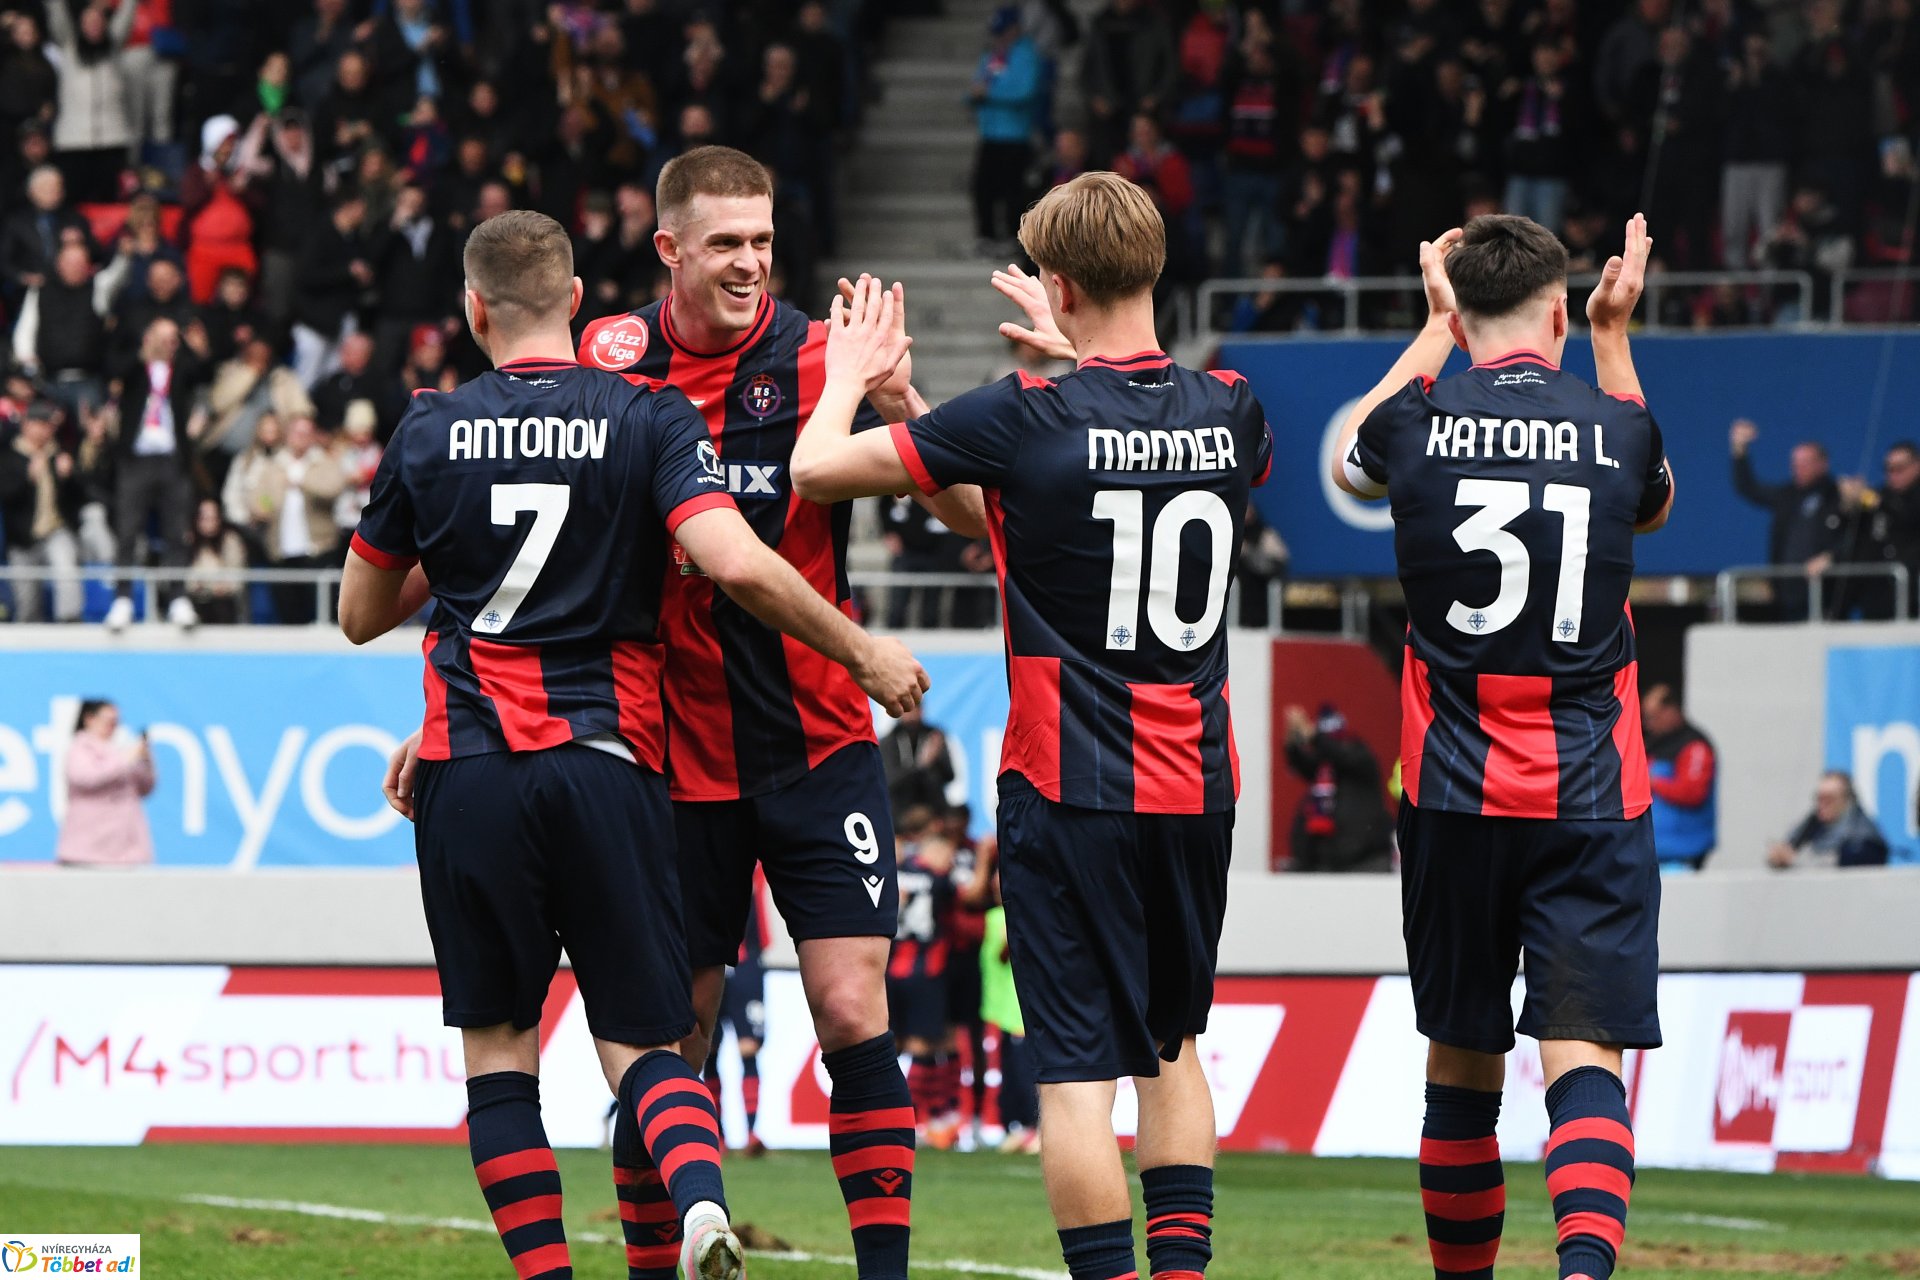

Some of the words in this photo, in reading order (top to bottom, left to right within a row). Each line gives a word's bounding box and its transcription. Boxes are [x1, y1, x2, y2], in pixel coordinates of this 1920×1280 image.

[607, 343, 636, 361] liga
[614, 329, 642, 347] fizz
[449, 416, 609, 461] ANTONOV
[1088, 427, 1238, 471] MANNER
[1425, 415, 1578, 462] KATONA
[1594, 424, 1620, 469] L.
[719, 464, 777, 493] IX
[470, 482, 571, 634] 7
[1091, 489, 1234, 652] 10
[1445, 478, 1591, 643] 31
[843, 812, 879, 865] 9
